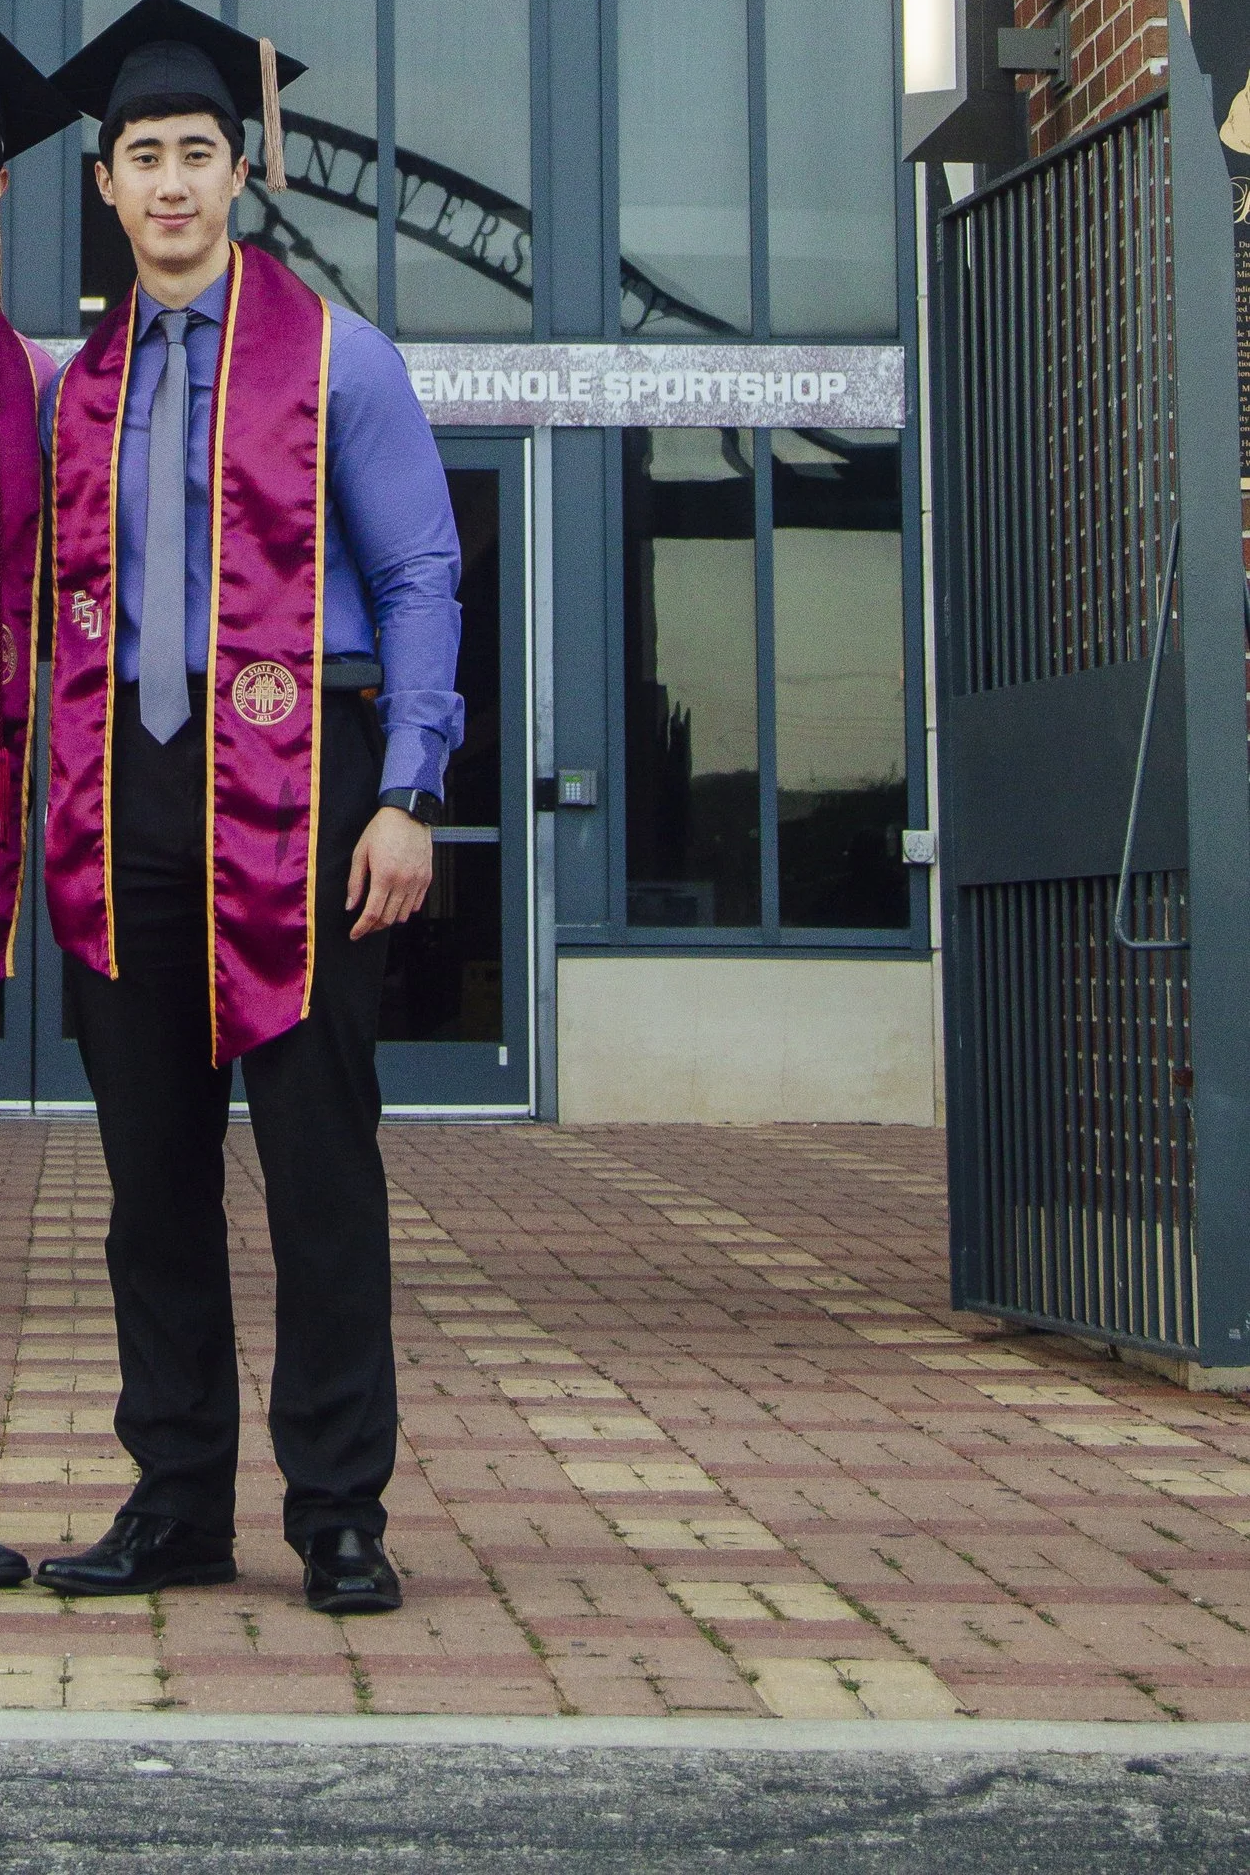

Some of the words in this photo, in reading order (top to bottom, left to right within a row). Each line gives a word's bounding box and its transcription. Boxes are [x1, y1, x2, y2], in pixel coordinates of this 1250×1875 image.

[410, 370, 592, 403] EMINOLE
[603, 370, 848, 404] SPORTSHOP
[71, 590, 102, 640] FSU
[236, 675, 250, 710] FLORIDA
[248, 665, 272, 676] STATE
[274, 667, 294, 711] UNIVERSITY
